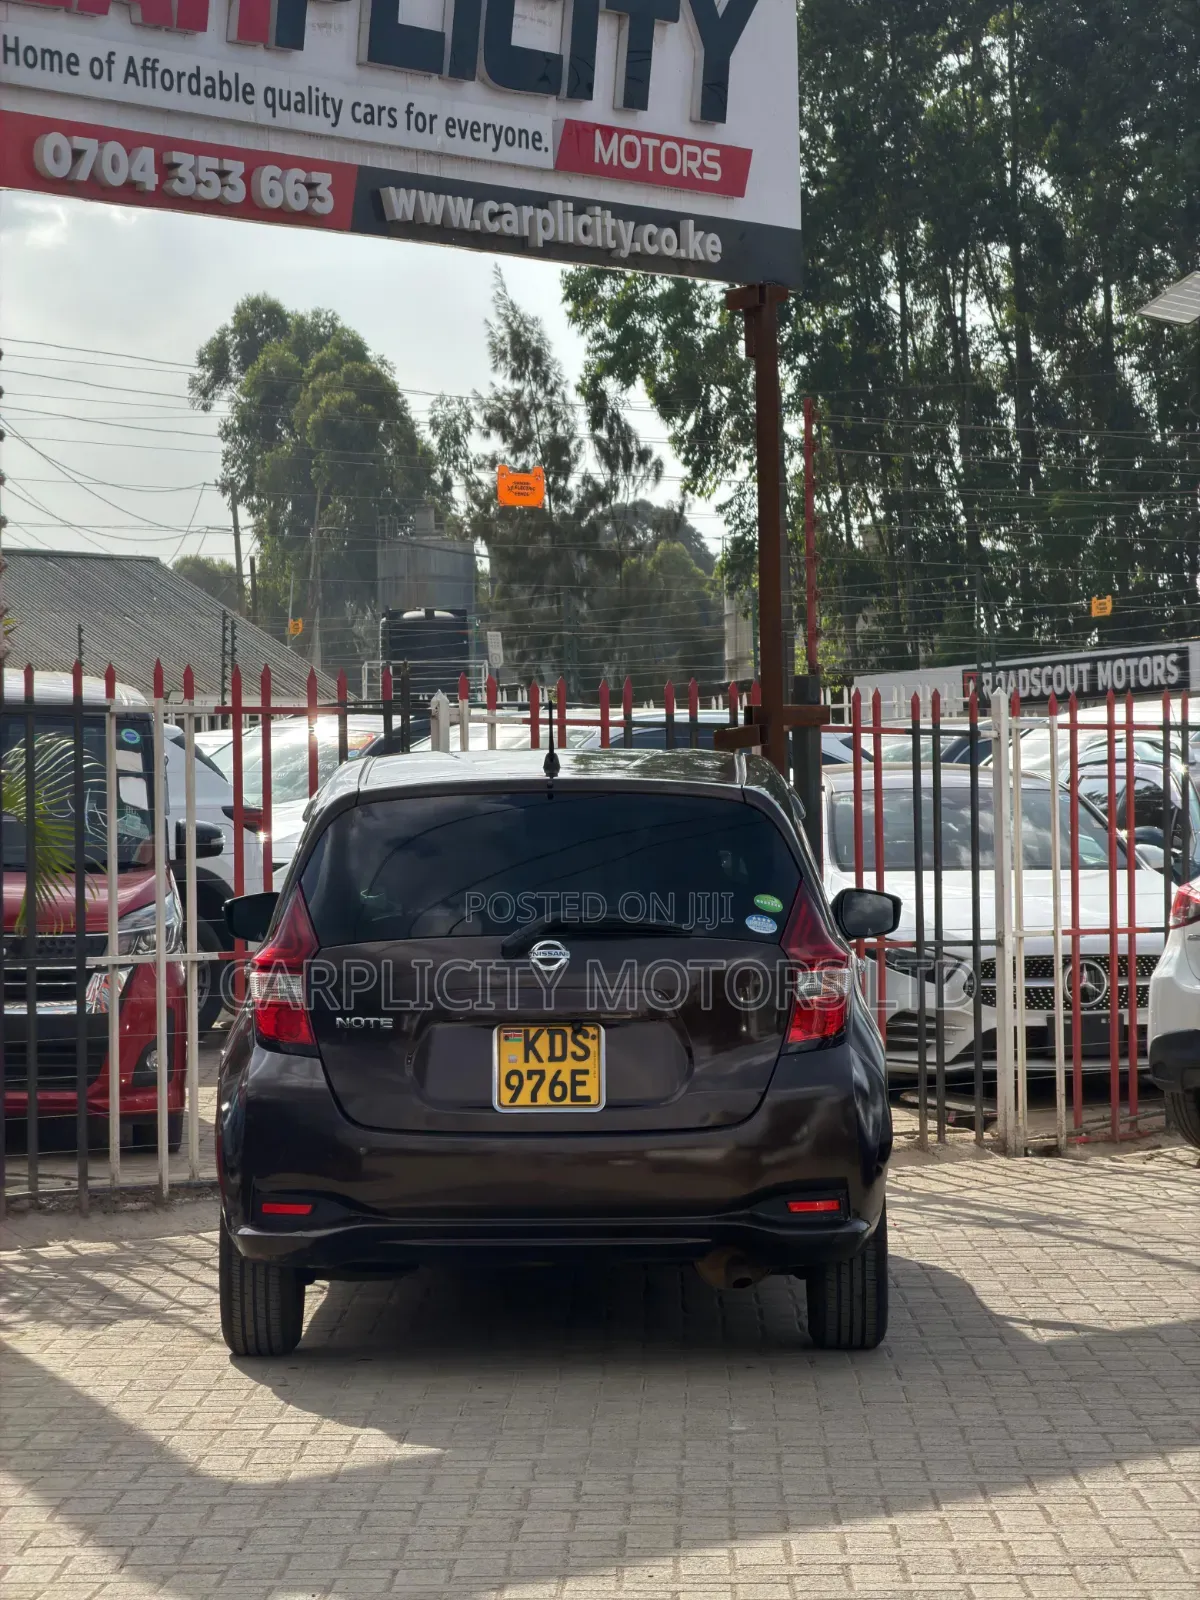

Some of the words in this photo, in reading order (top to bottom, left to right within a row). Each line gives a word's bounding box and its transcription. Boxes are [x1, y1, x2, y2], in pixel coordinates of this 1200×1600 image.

[2, 34, 80, 77] Home
[89, 51, 116, 82] of
[123, 55, 256, 106] Affordable
[263, 85, 344, 128] quality
[350, 101, 398, 130] cars
[404, 102, 438, 135] for
[444, 115, 549, 154] everyone.
[33, 131, 158, 193] 0704
[162, 150, 246, 205] 353
[251, 164, 334, 216] 663
[593, 129, 722, 182] MOTORS
[379, 186, 722, 264] www.carplicity.co.ke
[1096, 652, 1181, 692] MOTORS
[335, 1016, 394, 1029] NOTE
[523, 1027, 592, 1064] KDS
[504, 1068, 592, 1104] 976E
